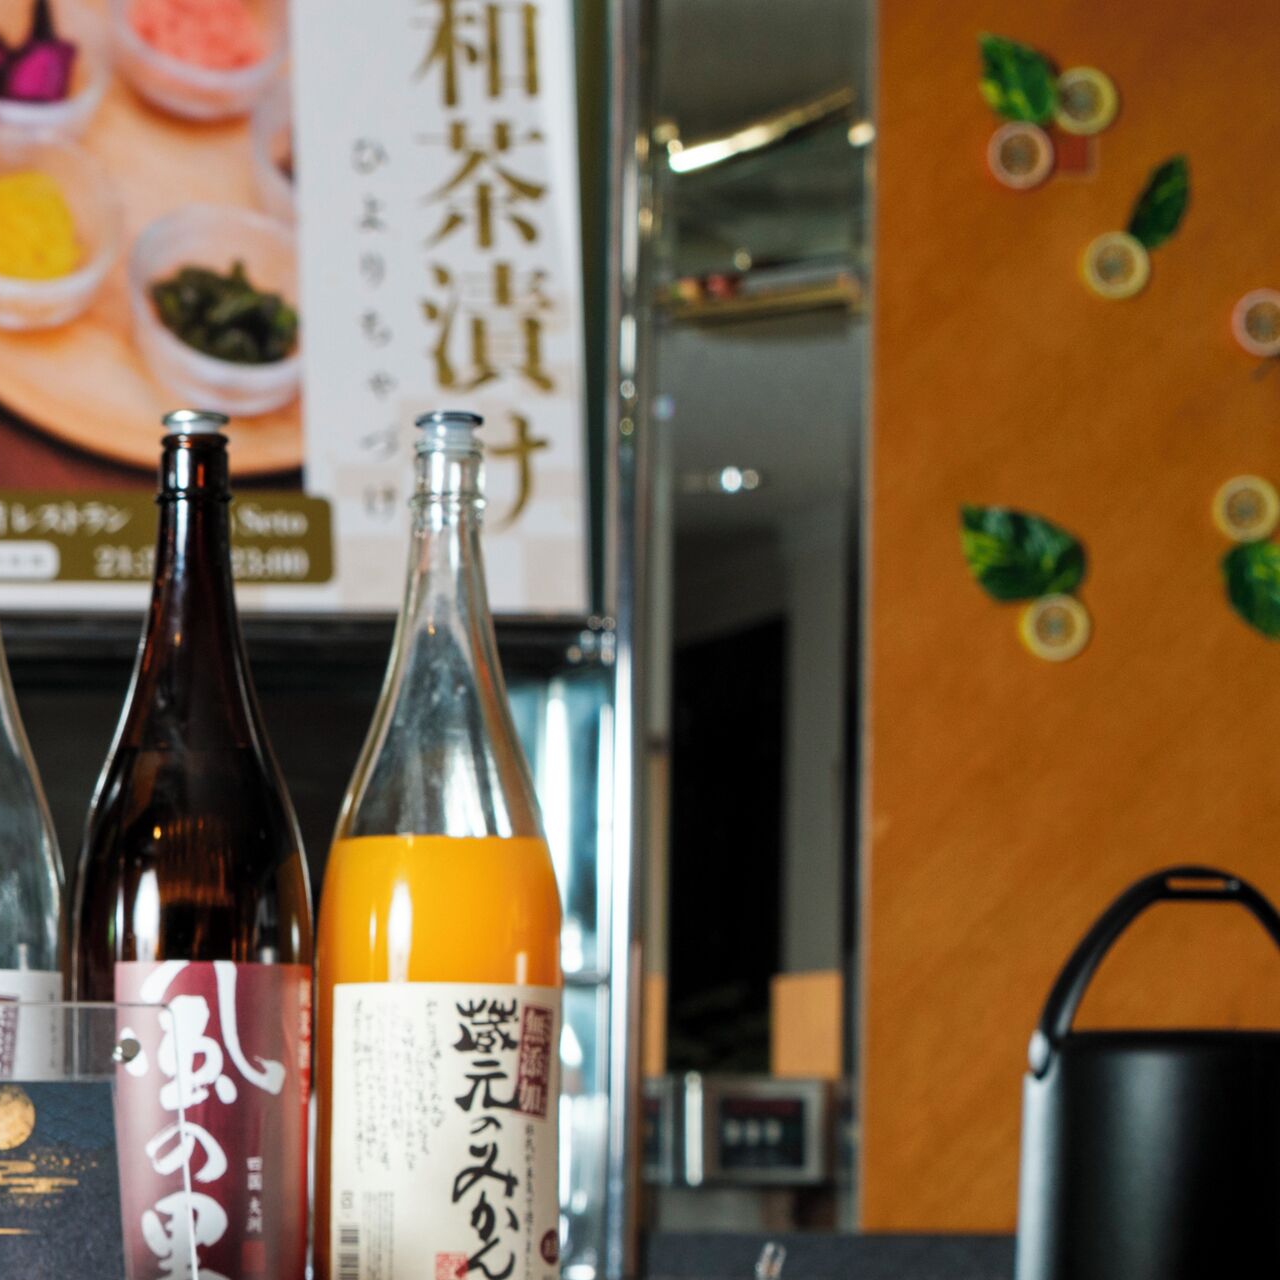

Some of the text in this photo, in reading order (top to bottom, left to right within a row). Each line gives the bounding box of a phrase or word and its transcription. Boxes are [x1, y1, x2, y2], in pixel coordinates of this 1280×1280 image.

[350, 138, 400, 525] ひよりちゃづけ
